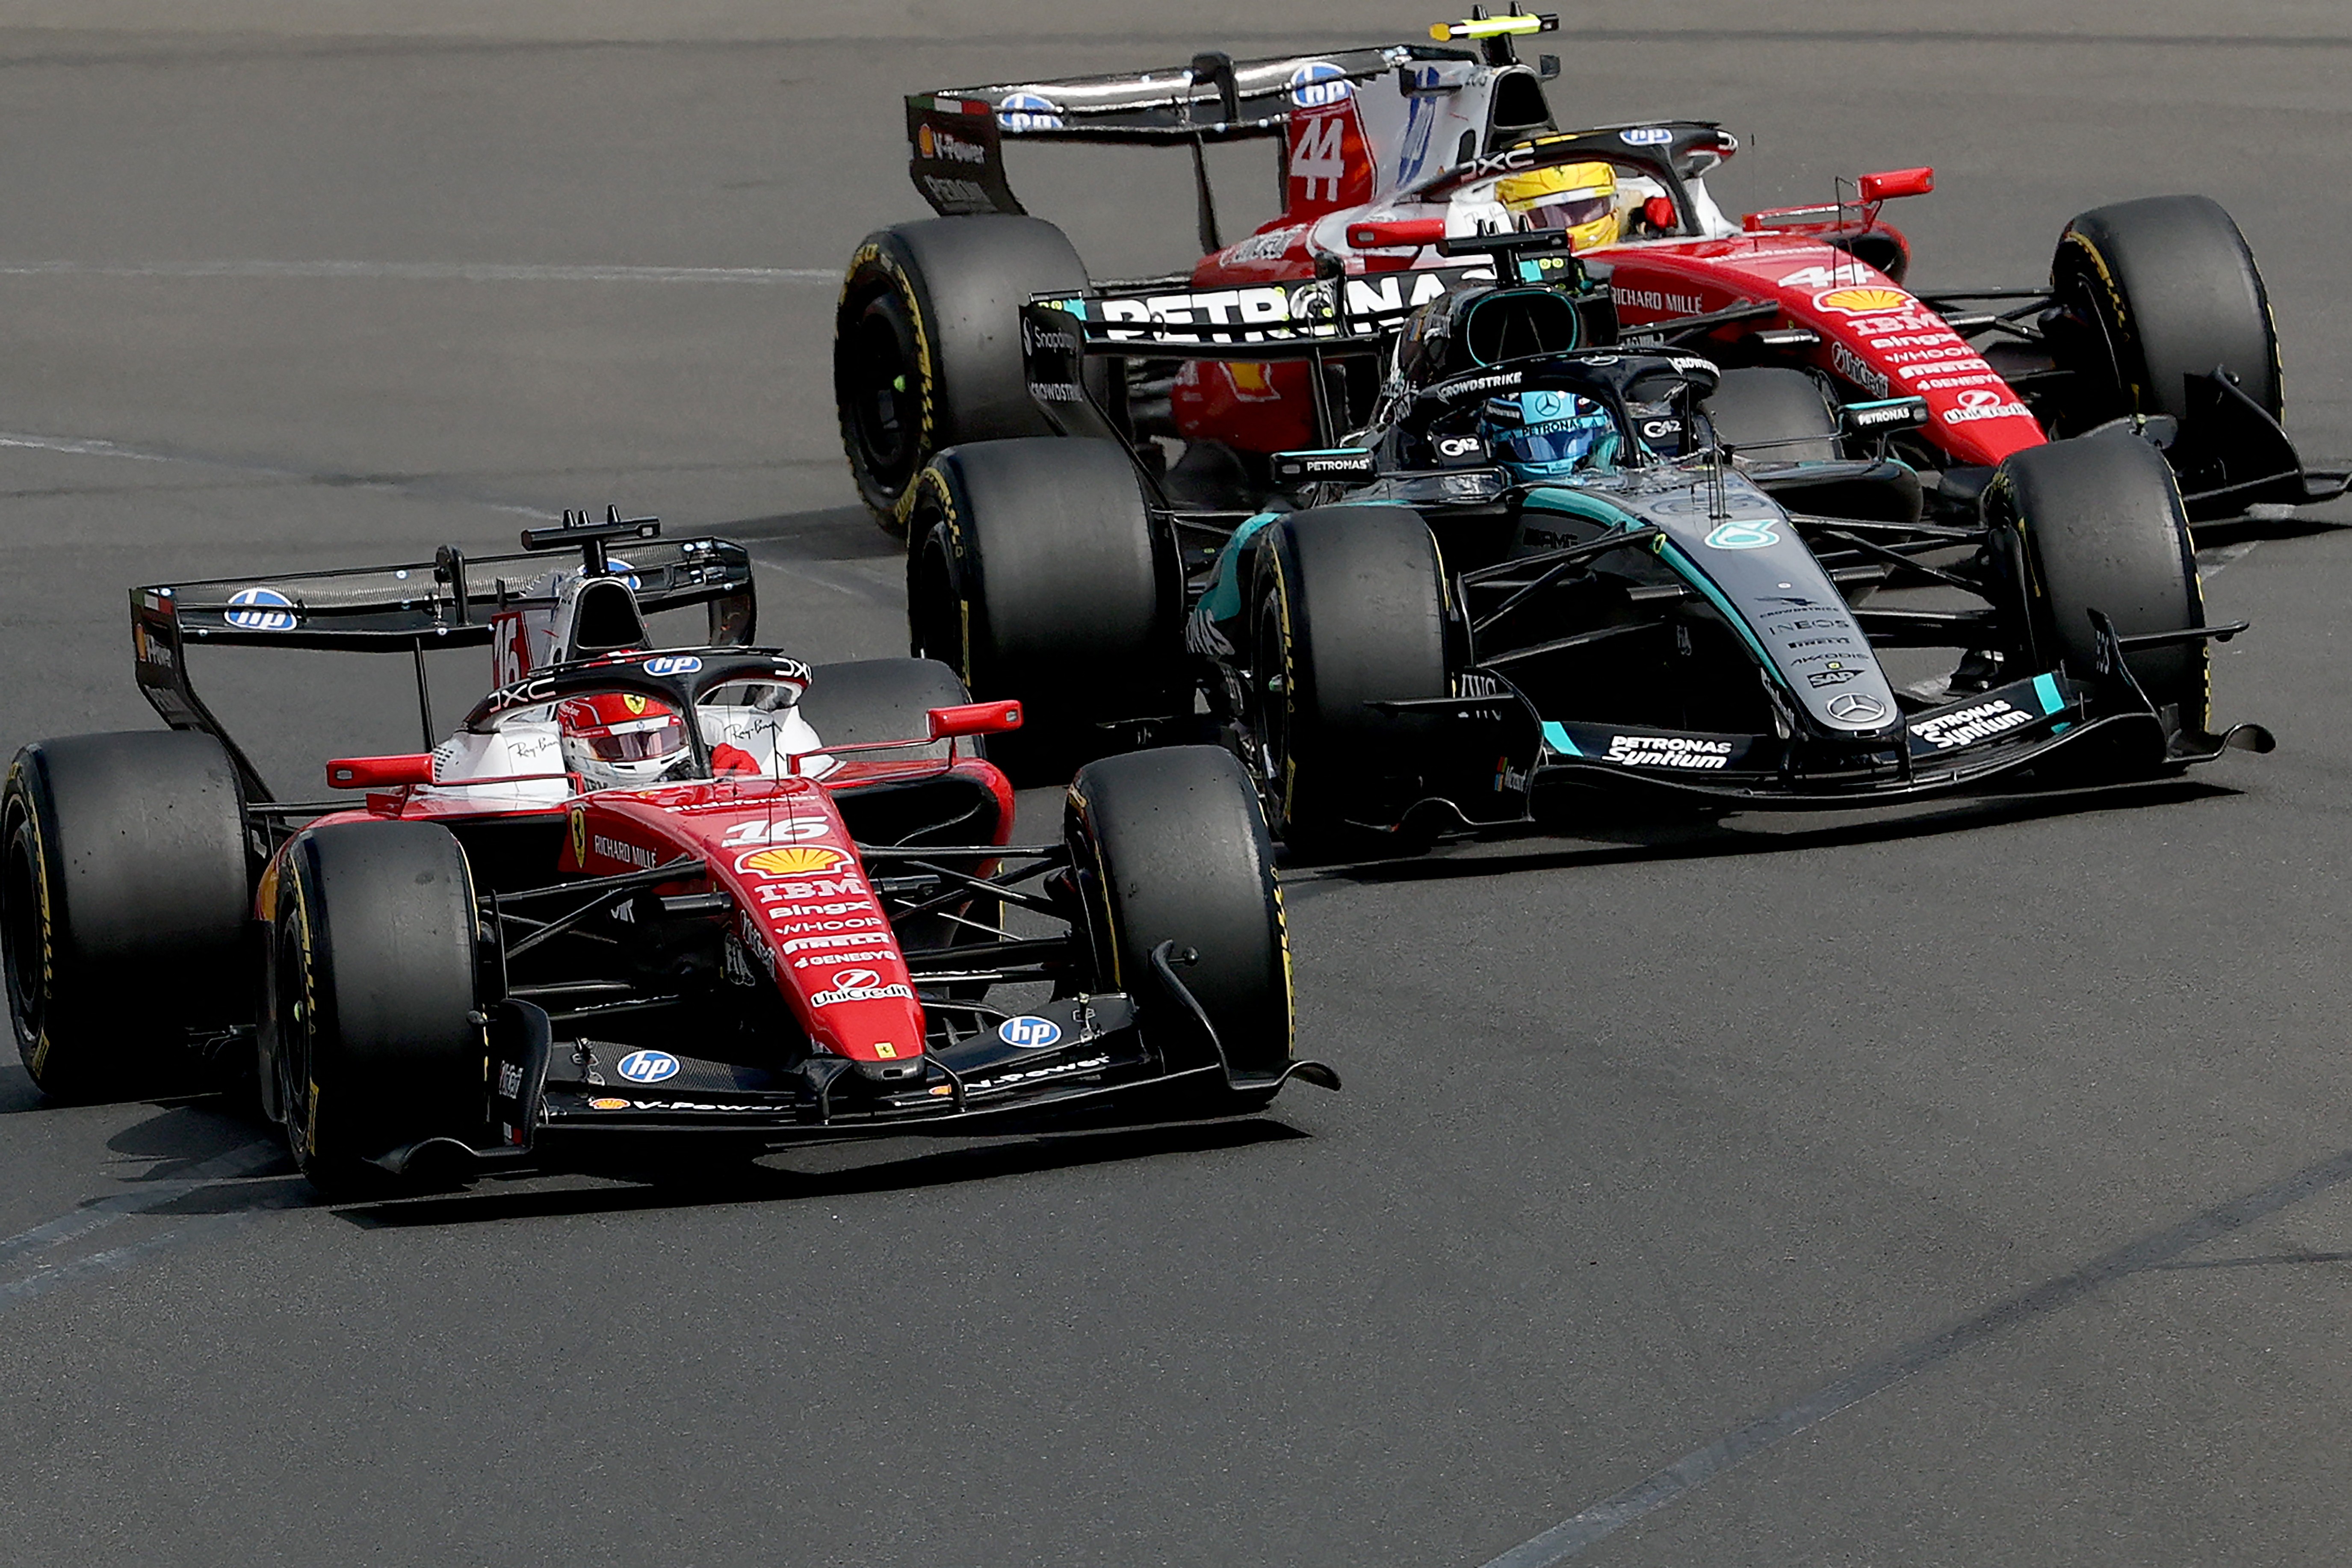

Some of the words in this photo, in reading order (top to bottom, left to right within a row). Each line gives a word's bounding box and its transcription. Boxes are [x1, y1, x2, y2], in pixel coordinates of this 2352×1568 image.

[1290, 116, 1344, 202] 44
[1459, 148, 1535, 183] DXC
[1779, 263, 1875, 288] 44
[1102, 269, 1496, 343] PETRONA
[1611, 286, 1662, 310] RICHARD
[1665, 293, 1702, 314] MILLE
[1847, 313, 1949, 337] IBM
[1439, 371, 1522, 400] CROWDSTRIKE
[1522, 419, 1582, 436] PETRONAS
[1859, 408, 1909, 425] PETRONAS
[1307, 460, 1368, 471] PETRONAS
[1769, 619, 1850, 635] INEOS
[653, 657, 694, 672] hp
[1809, 671, 1855, 686] SAP
[488, 677, 556, 713] DXC
[1910, 700, 2011, 736] PETRONAS
[1924, 710, 2033, 748] Syntium
[1601, 747, 1728, 768] Syntium
[1610, 736, 1732, 754] PETRONAS
[721, 816, 829, 847] 16
[595, 835, 630, 863] RICHARD
[632, 846, 656, 870] MILLE
[754, 879, 868, 904] IBM
[774, 917, 882, 935] WHOOP
[810, 950, 897, 965] GENESYS
[813, 985, 911, 1006] UniCredit
[1012, 1018, 1052, 1047] hp
[631, 1052, 672, 1080] hp
